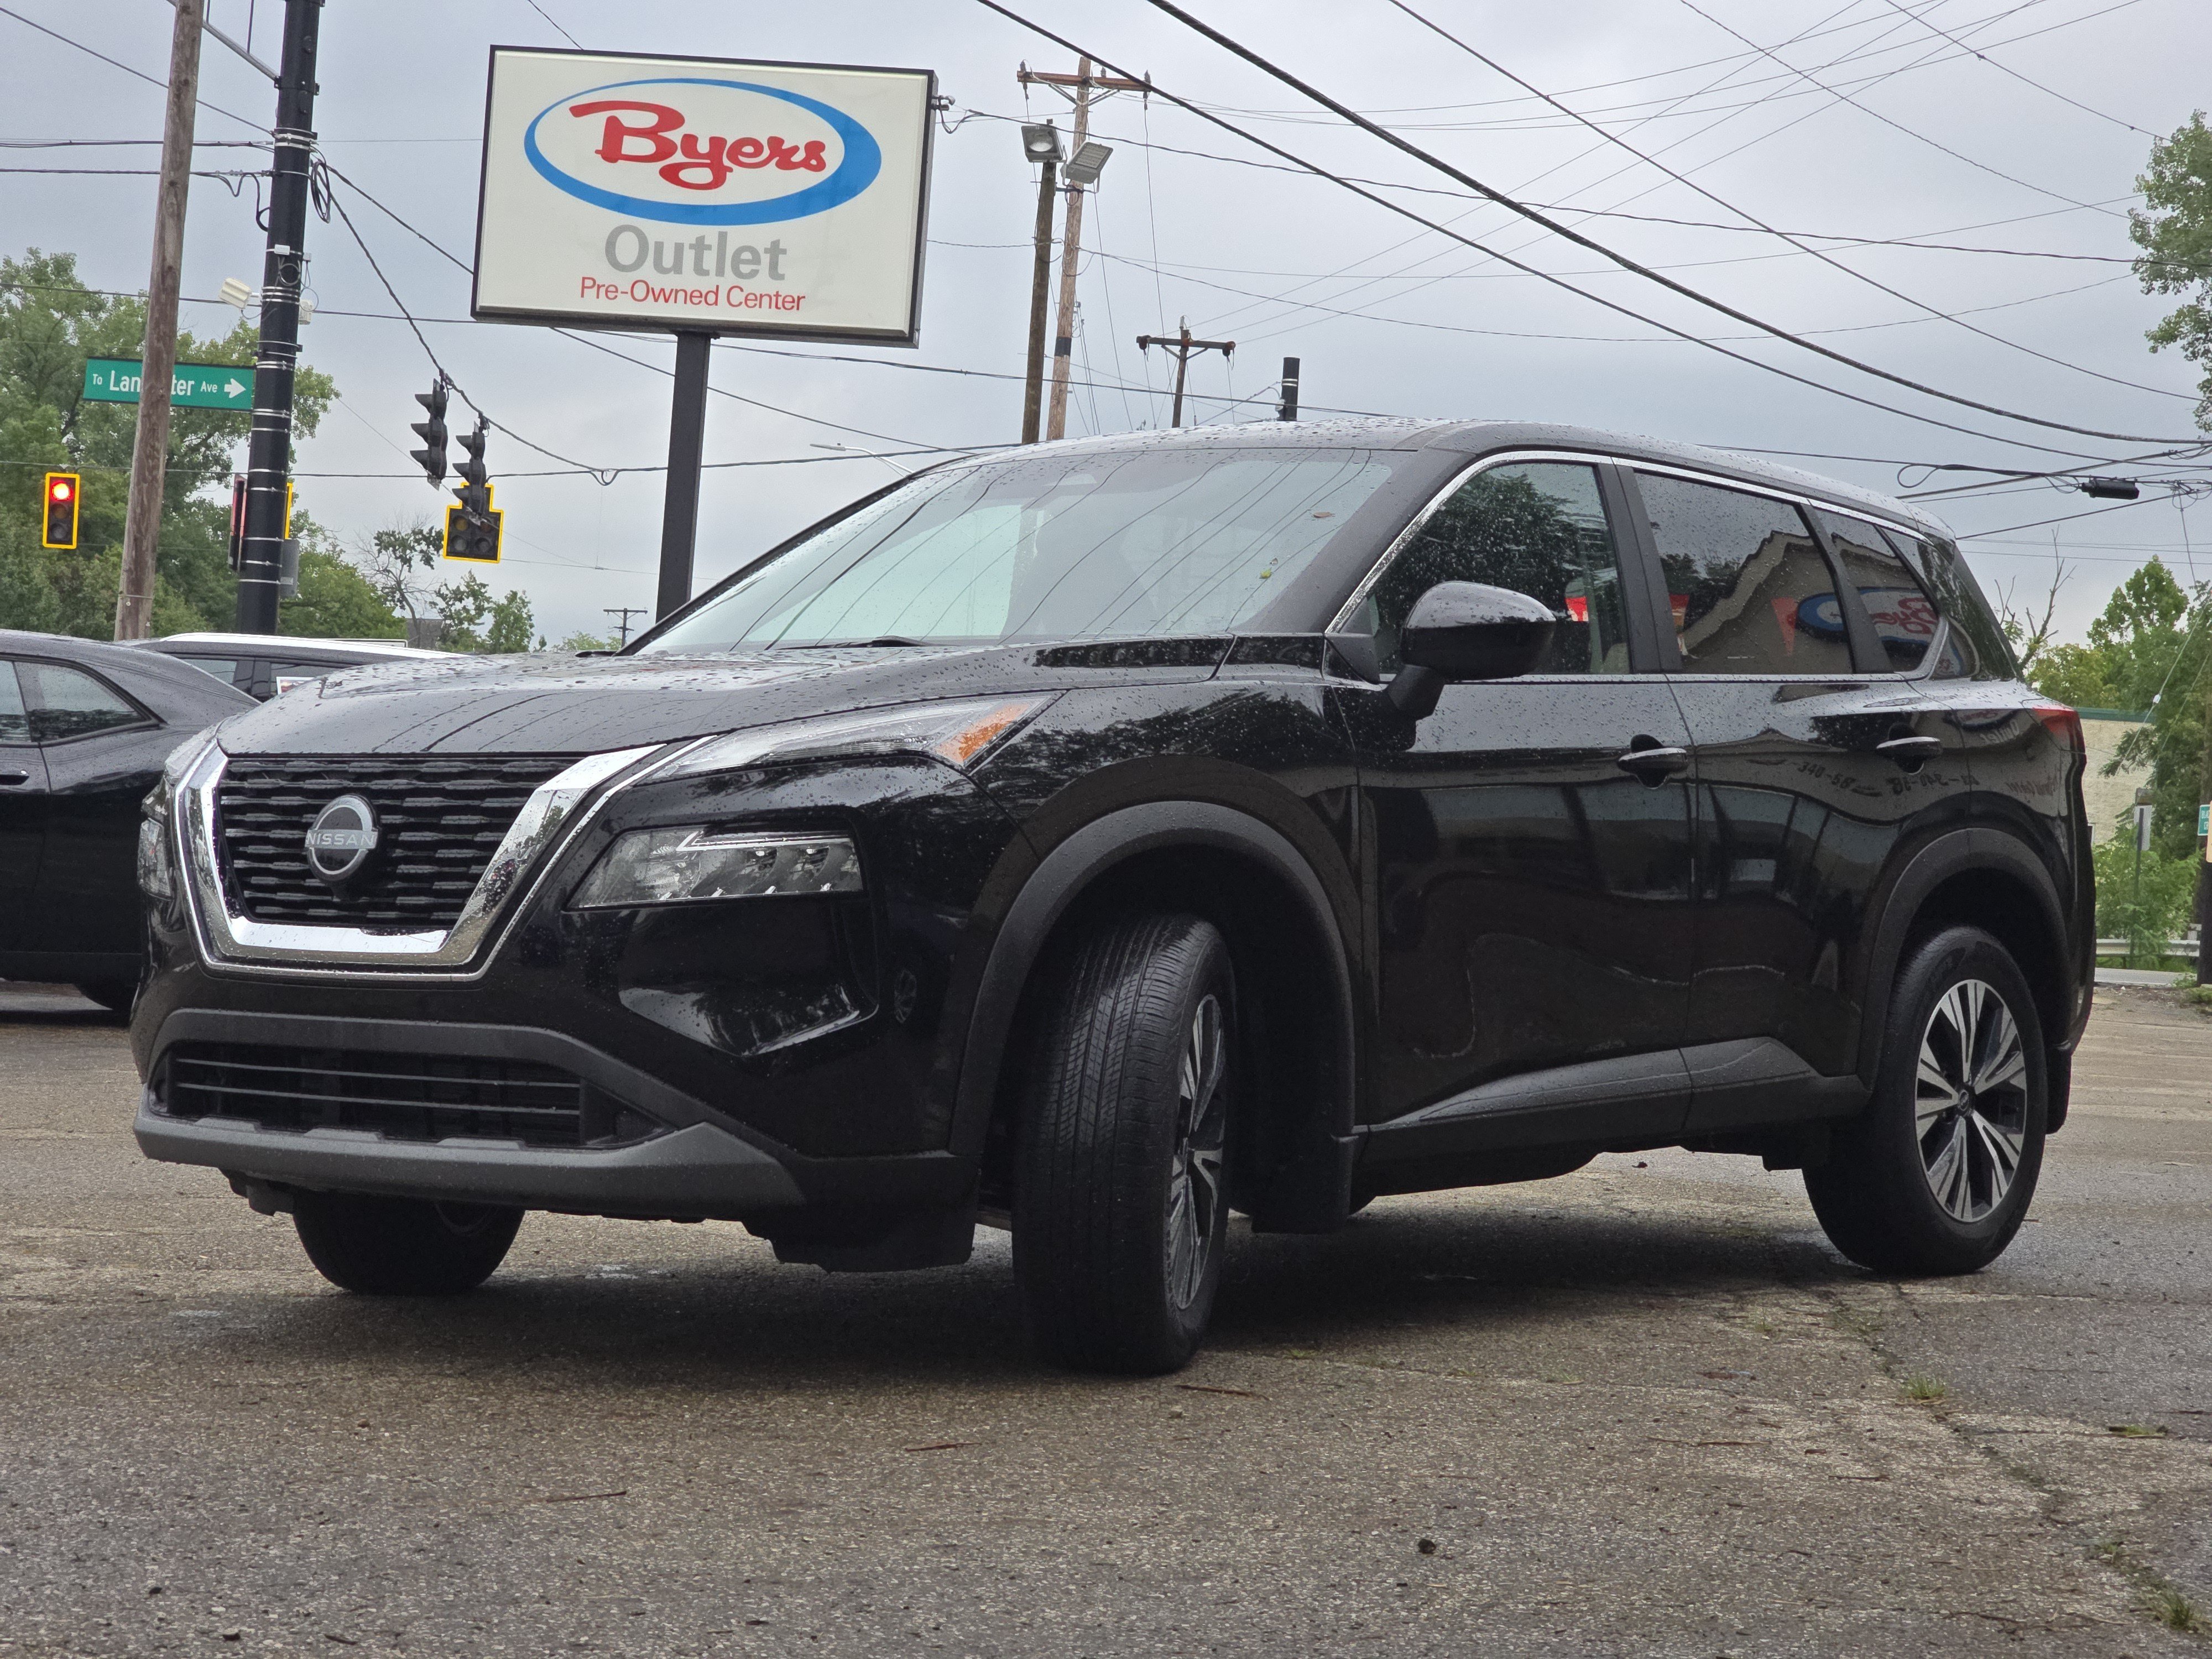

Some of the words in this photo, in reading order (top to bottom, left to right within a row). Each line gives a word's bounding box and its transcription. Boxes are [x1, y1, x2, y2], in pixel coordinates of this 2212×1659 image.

[569, 101, 827, 191] Byers
[604, 224, 787, 281] Outlet
[581, 276, 720, 306] Pre-Owned
[727, 285, 806, 311] Center
[93, 374, 103, 385] To
[109, 370, 195, 397] Lanter
[201, 381, 218, 394] Ave
[306, 832, 375, 846] NISSAN
